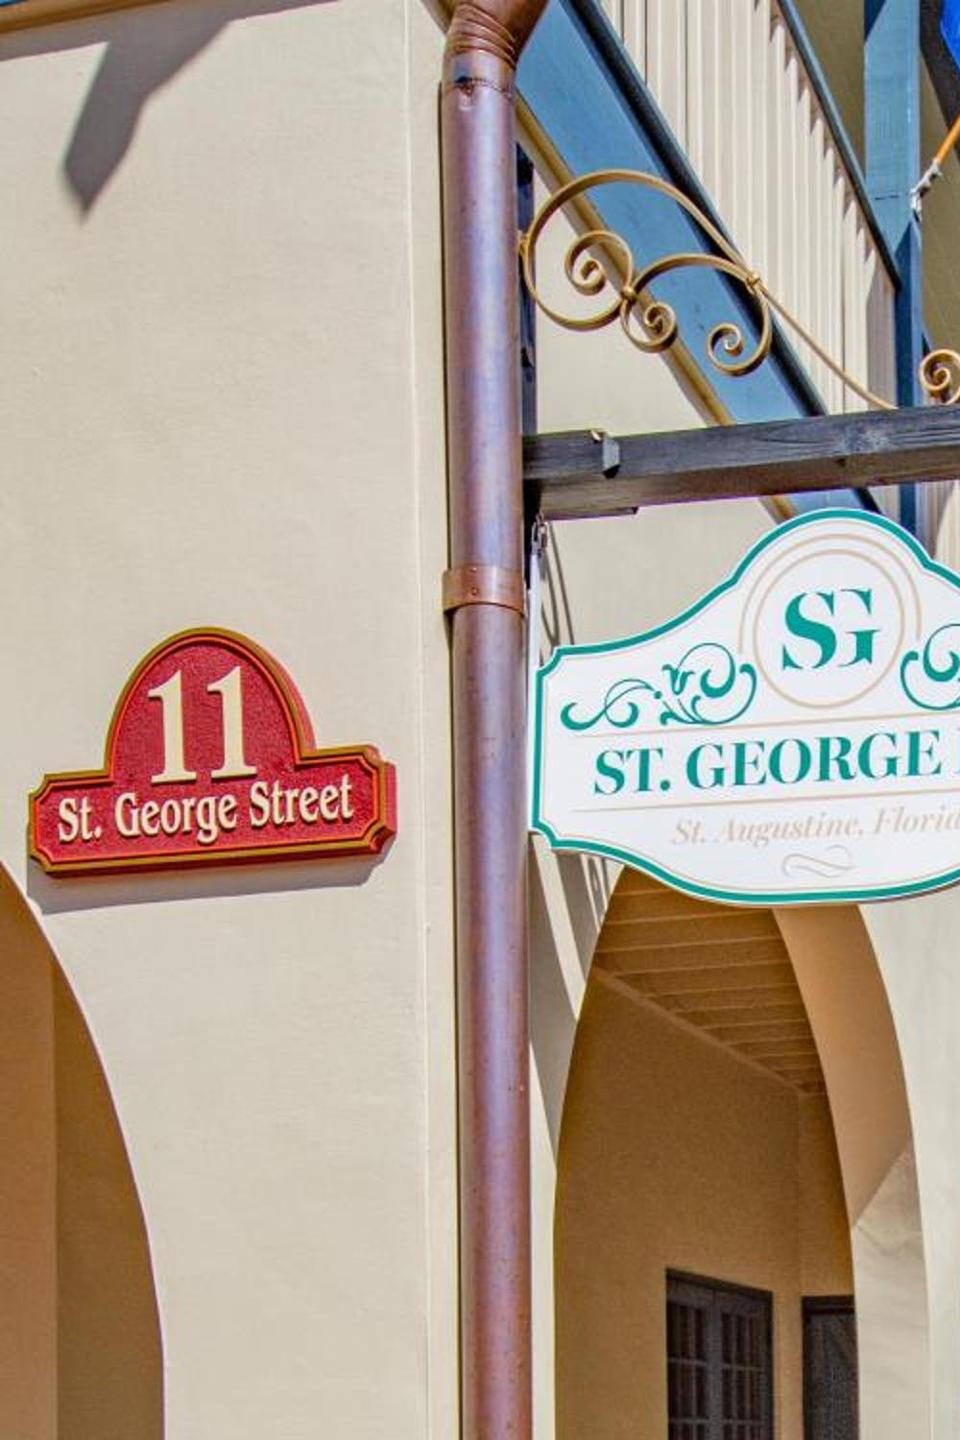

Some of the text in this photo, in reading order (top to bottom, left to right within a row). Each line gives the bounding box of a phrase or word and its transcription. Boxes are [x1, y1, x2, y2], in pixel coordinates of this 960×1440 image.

[781, 587, 883, 673] SG
[147, 665, 258, 786] 11
[593, 746, 671, 796] ST.
[685, 729, 943, 791] GEORGE
[58, 774, 355, 845] St. George Street
[670, 819, 708, 848] St.
[718, 810, 866, 850] Augustine,
